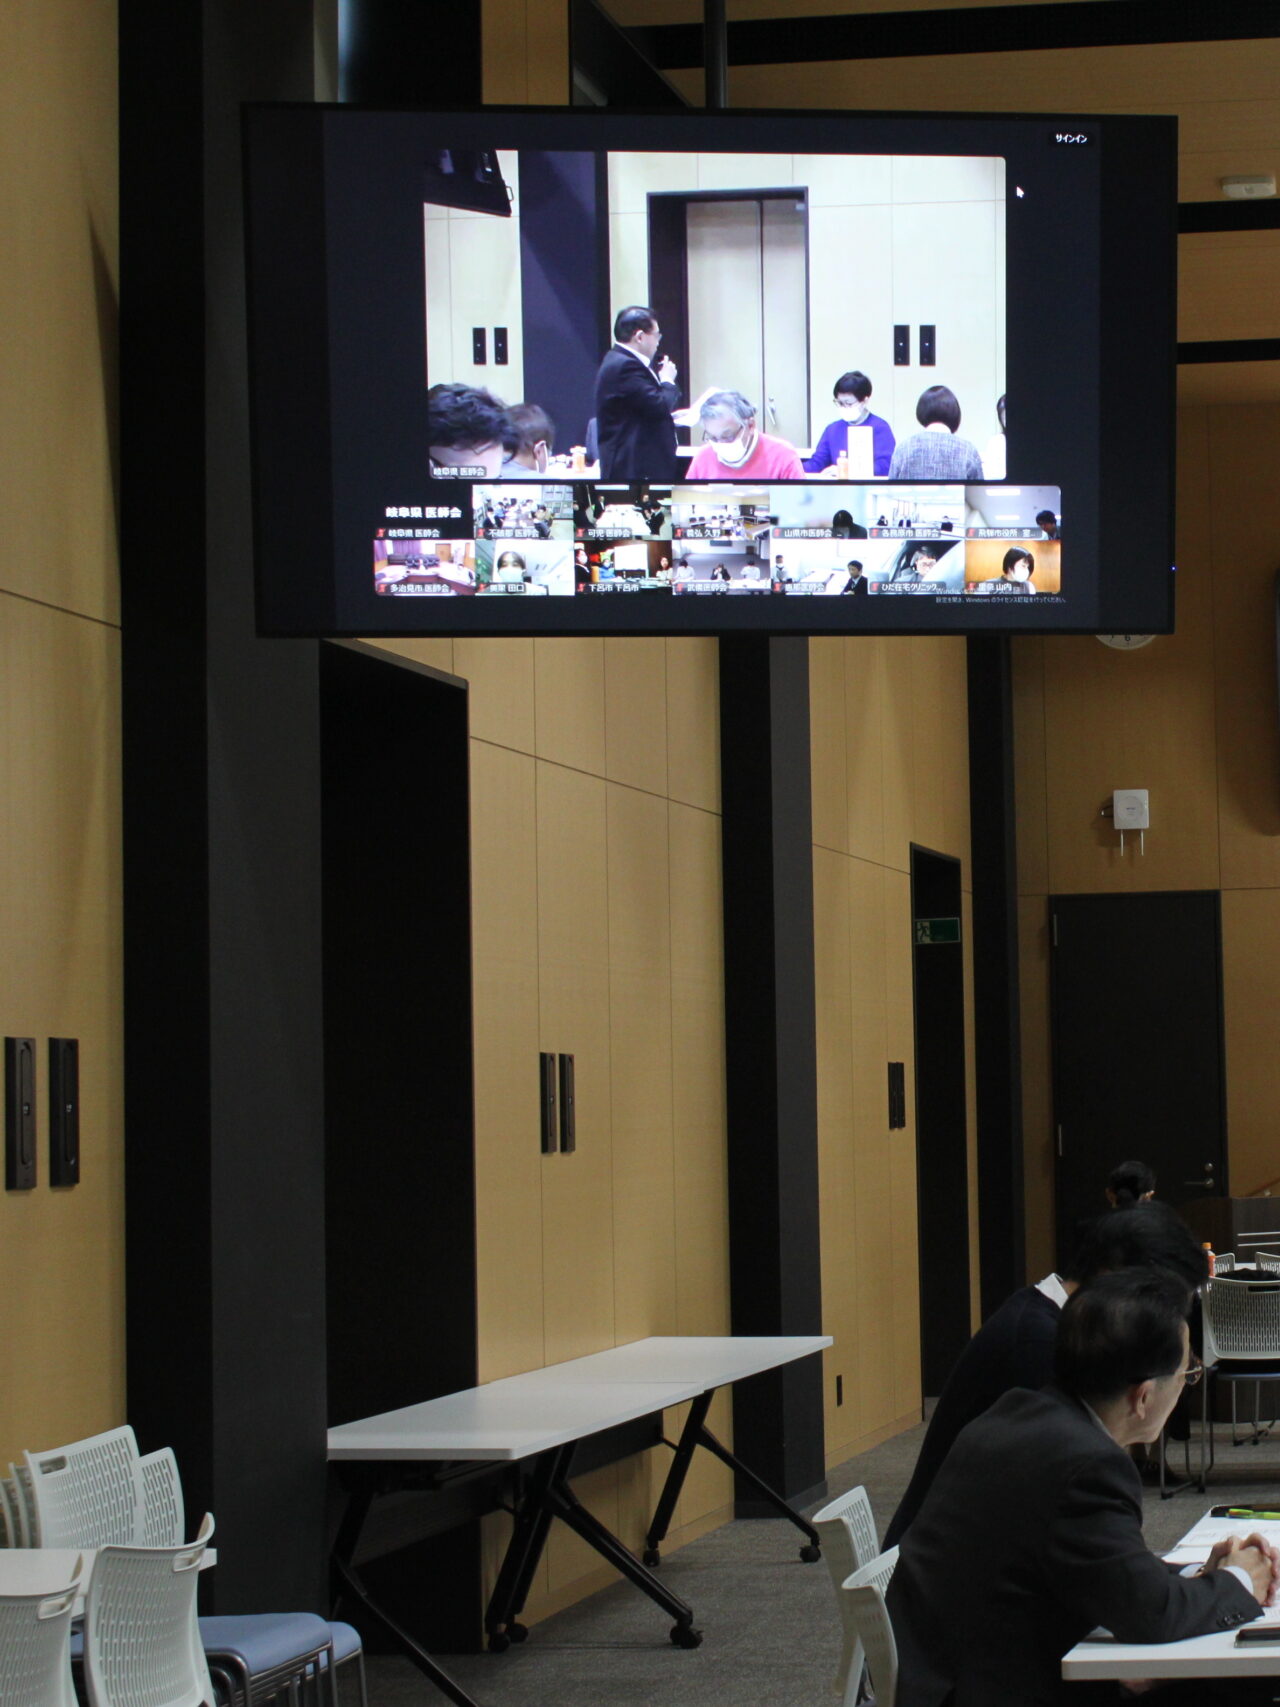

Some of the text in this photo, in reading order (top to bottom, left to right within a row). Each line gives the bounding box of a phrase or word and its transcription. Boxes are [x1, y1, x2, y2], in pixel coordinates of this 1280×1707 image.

[1055, 133, 1088, 144] サインイン
[433, 467, 485, 476] 岐阜県 医師会
[385, 506, 462, 518] 岐阜県 医師会
[388, 528, 440, 538] 岐阜県 医師会
[515, 528, 540, 538] 医師会
[607, 528, 631, 538] 医師会
[784, 528, 832, 538] 山県市医師会
[915, 528, 939, 538] 医師会
[390, 583, 450, 593] 多治見市 医師会
[508, 584, 525, 593] 田口
